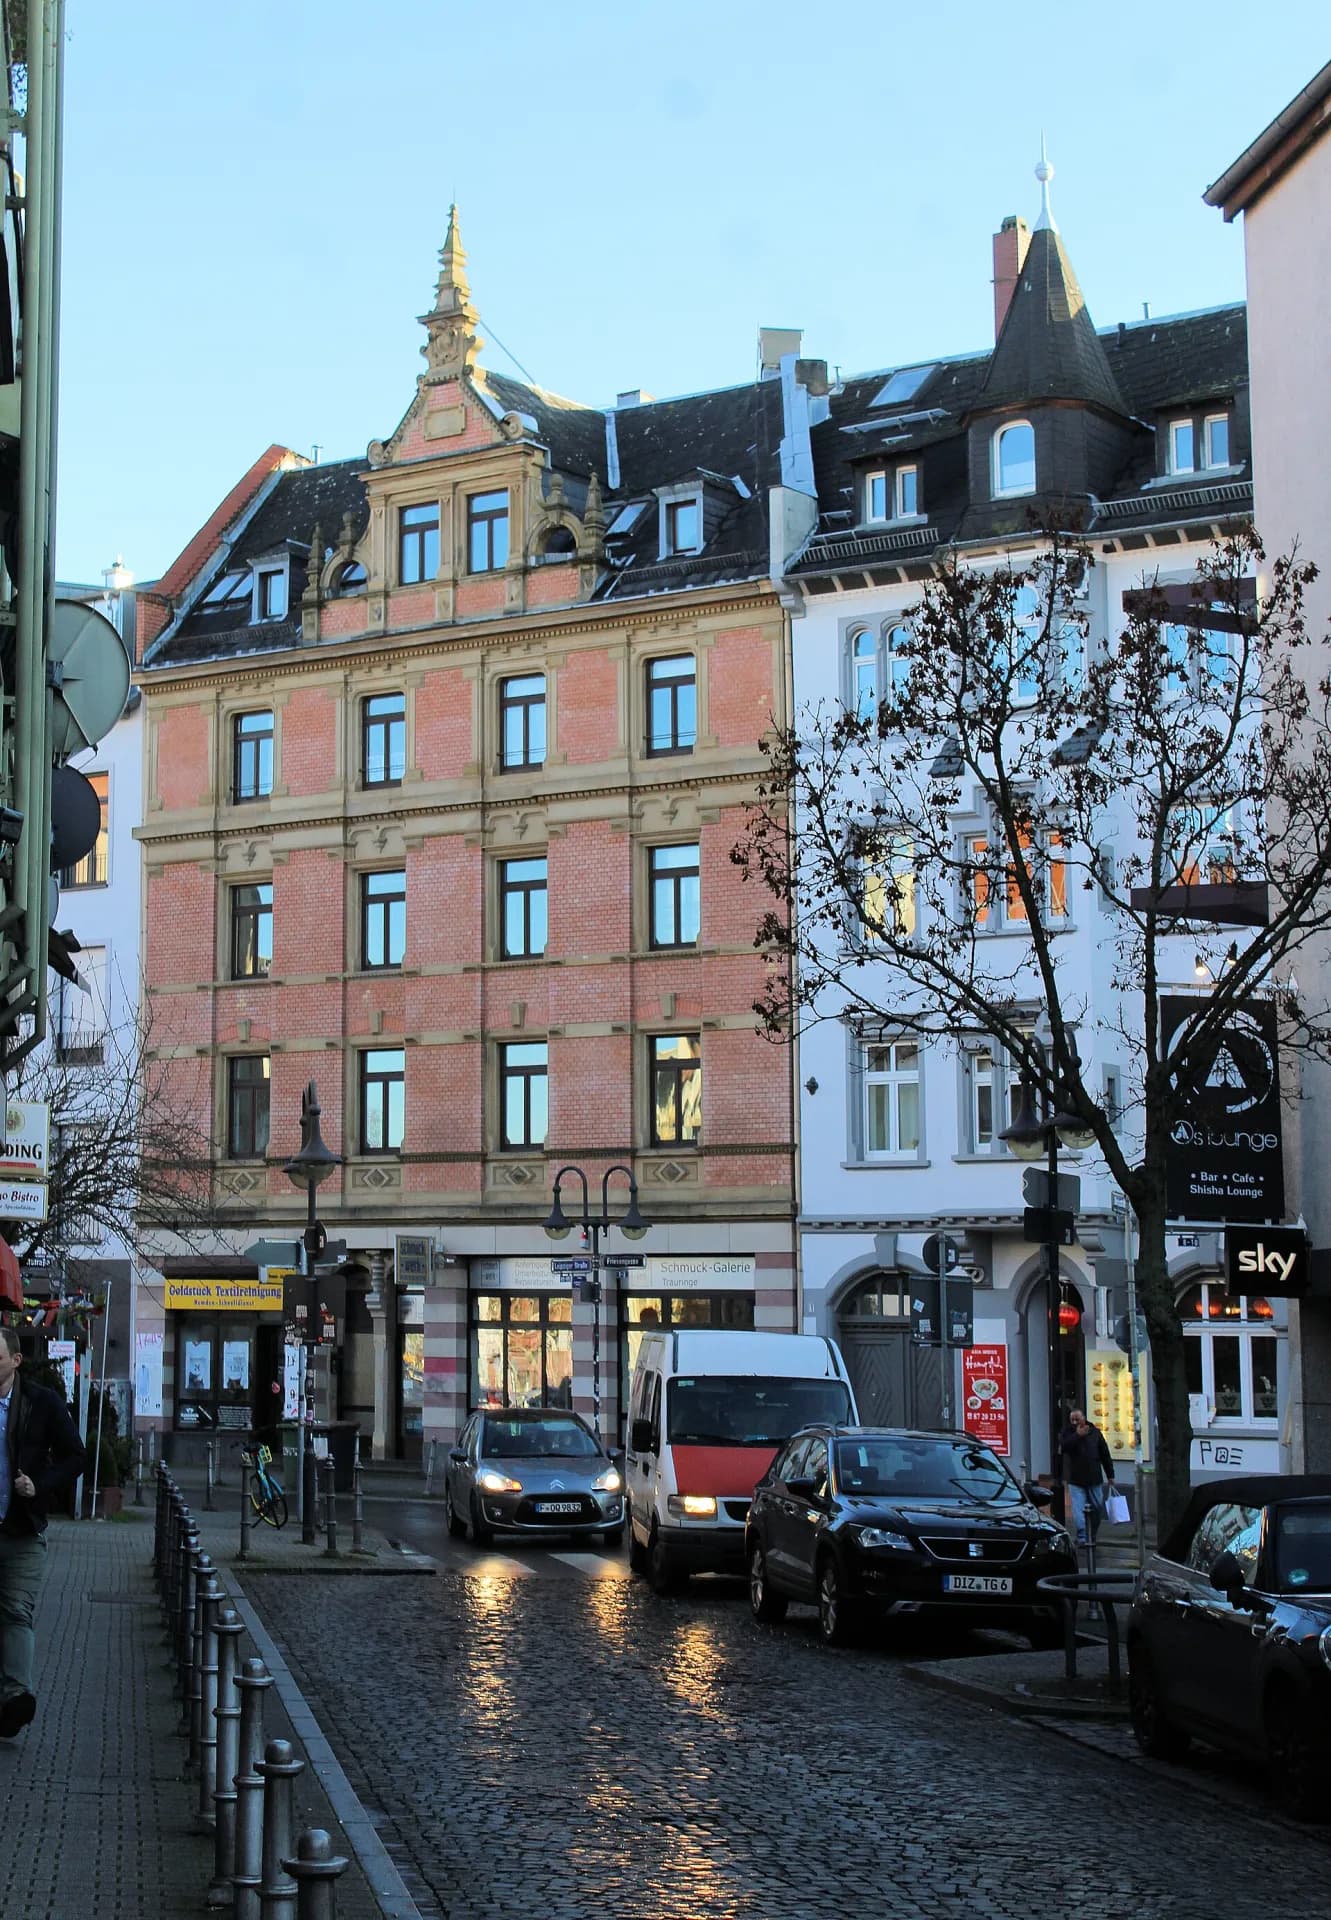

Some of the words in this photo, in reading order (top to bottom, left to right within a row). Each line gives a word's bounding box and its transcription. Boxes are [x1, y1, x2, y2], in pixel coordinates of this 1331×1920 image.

[1200, 1171, 1218, 1182] Bar
[1232, 1173, 1255, 1184] Cafe
[11, 1190, 39, 1203] Bistro
[1189, 1184, 1224, 1195] Shisha
[1226, 1186, 1264, 1199] Lounge
[660, 1262, 751, 1273] Schmuck-Galerie
[1238, 1242, 1297, 1281] sky
[216, 1285, 281, 1299] Textilreinigung
[953, 1576, 976, 1590] DIZ
[983, 1578, 998, 1590] TG
[1000, 1579, 1008, 1591] 6
